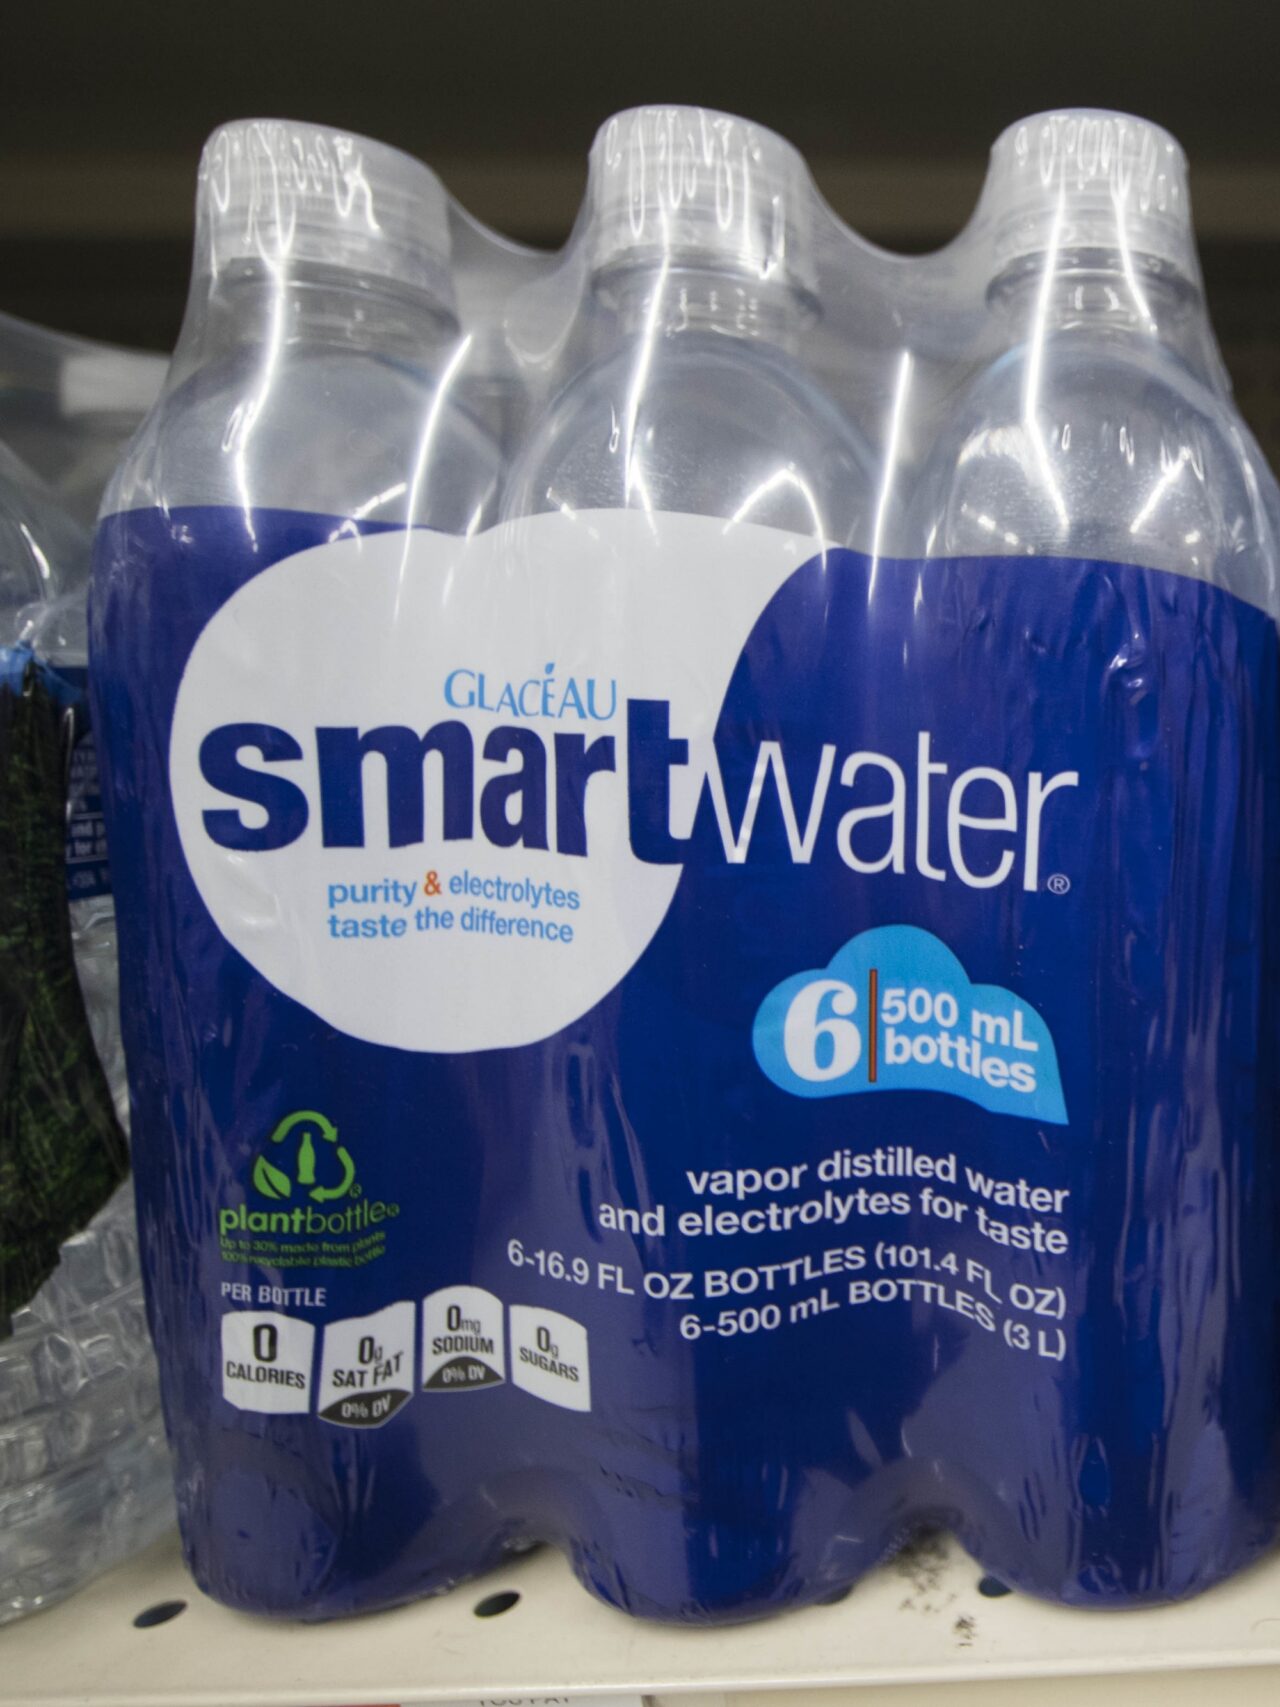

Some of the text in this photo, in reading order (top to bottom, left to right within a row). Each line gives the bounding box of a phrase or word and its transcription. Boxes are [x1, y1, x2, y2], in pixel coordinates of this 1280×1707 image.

[443, 662, 617, 721] GLACÉAU
[327, 869, 581, 910] purity & electrolytes
[327, 906, 574, 943] taste the difference
[783, 979, 862, 1082] 6
[881, 988, 1039, 1052] 500 mL
[885, 1027, 1037, 1093] bottles
[686, 1147, 1070, 1214] vapor distilled water
[599, 1187, 1068, 1255] and electrolytes for taste
[221, 1281, 327, 1307] PER BOTTLE
[507, 1239, 1067, 1319] 6-16.9 FL OZ BOTTLES (101.4 FL OZ)
[680, 1278, 1067, 1361] 6-500 mL BOTTLES (3 L)
[253, 1323, 277, 1363] 0
[432, 1334, 494, 1355] SODIUM
[226, 1360, 306, 1390] CALORIES
[332, 1351, 403, 1388] SAT FAT
[442, 1366, 486, 1383] 0% DV
[520, 1346, 580, 1383] SUGARS
[341, 1393, 391, 1418] 0% DV
